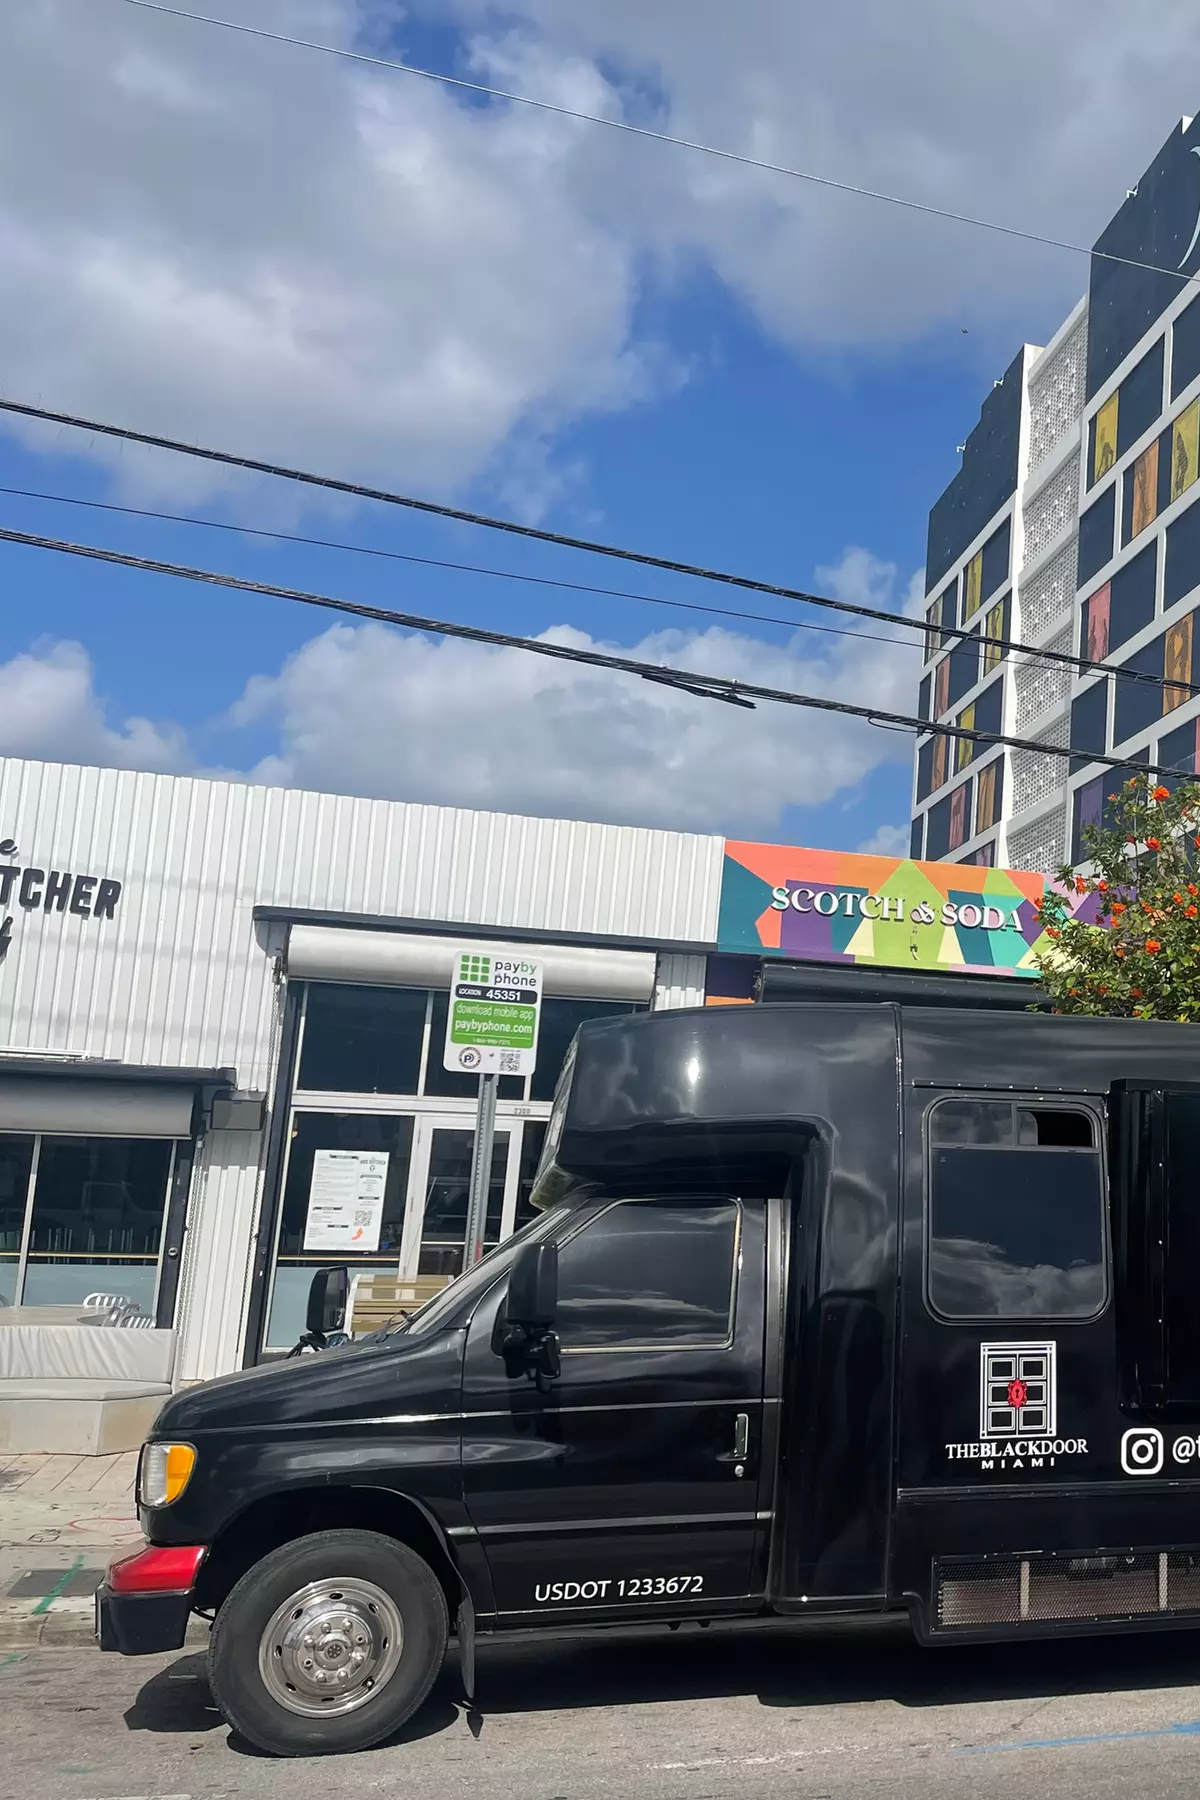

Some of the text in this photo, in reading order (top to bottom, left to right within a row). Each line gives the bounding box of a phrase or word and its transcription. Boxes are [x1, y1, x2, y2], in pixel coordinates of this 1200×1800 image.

[770, 886, 1024, 933] SCOTCH & SODA
[494, 973, 537, 987] phone
[458, 988, 521, 1002] LOCATION 45351
[456, 1003, 534, 1021] download mobile app
[455, 1018, 533, 1034] paybyphone.com
[945, 1437, 1089, 1460] THEBLACKDOOR
[981, 1457, 1057, 1470] MIAMI
[534, 1575, 704, 1602] USDOT 1233672
